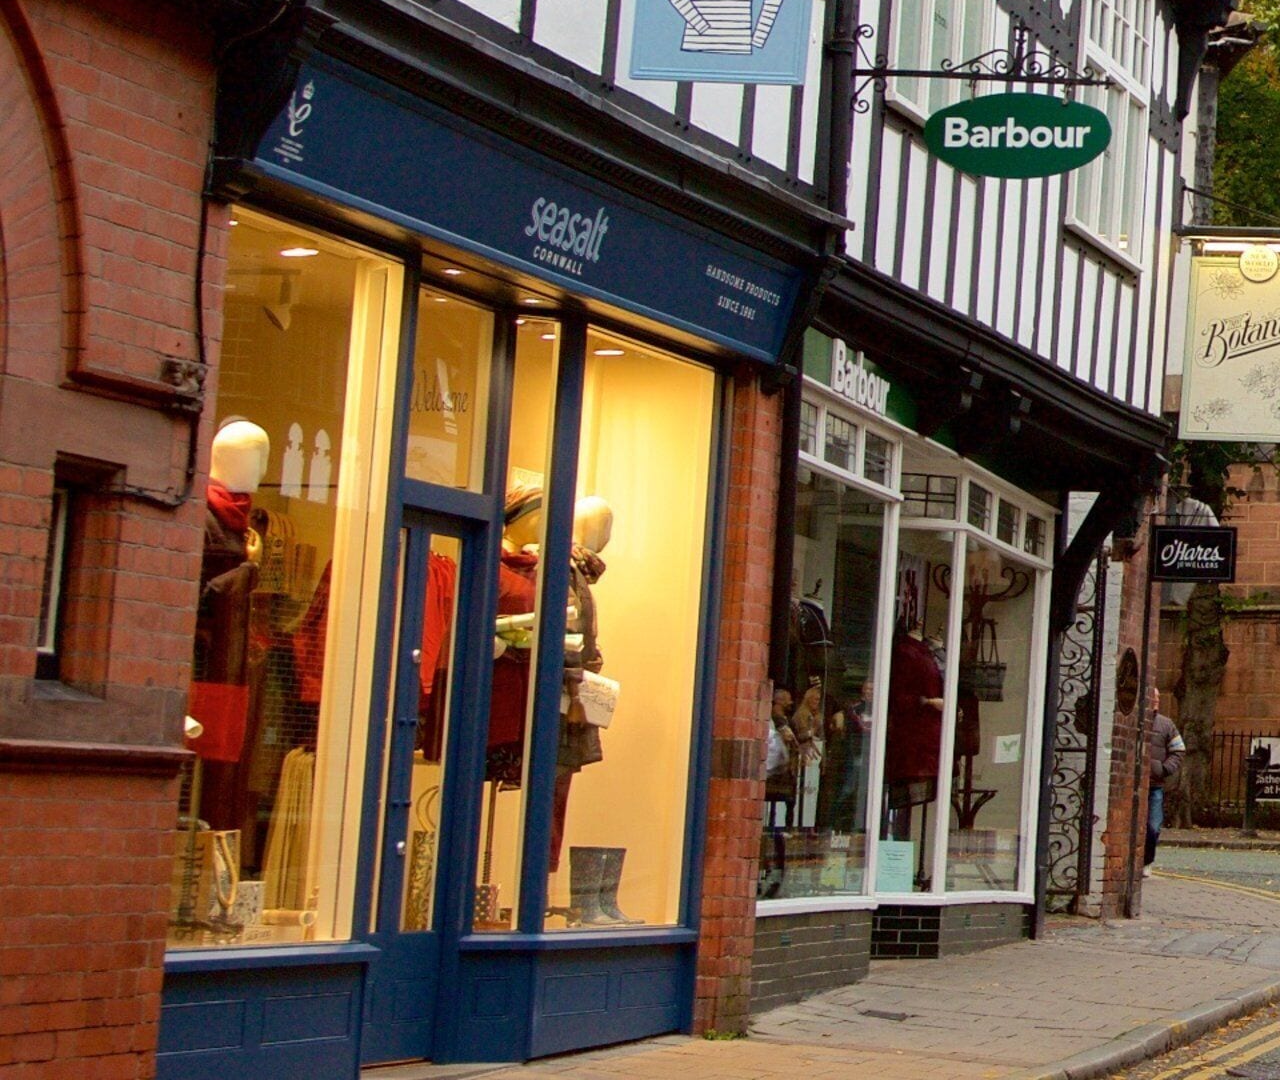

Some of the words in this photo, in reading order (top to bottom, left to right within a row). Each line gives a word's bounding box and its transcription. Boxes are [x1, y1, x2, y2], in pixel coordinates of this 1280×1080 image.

[944, 117, 1091, 148] Barbour
[525, 197, 609, 263] seasalt
[533, 245, 583, 275] CORNWALL
[718, 295, 741, 313] SINCE
[831, 337, 890, 416] Barbour
[1161, 540, 1225, 567] O'Hares
[1177, 561, 1220, 571] JEWELLERS
[1263, 785, 1274, 795] at
